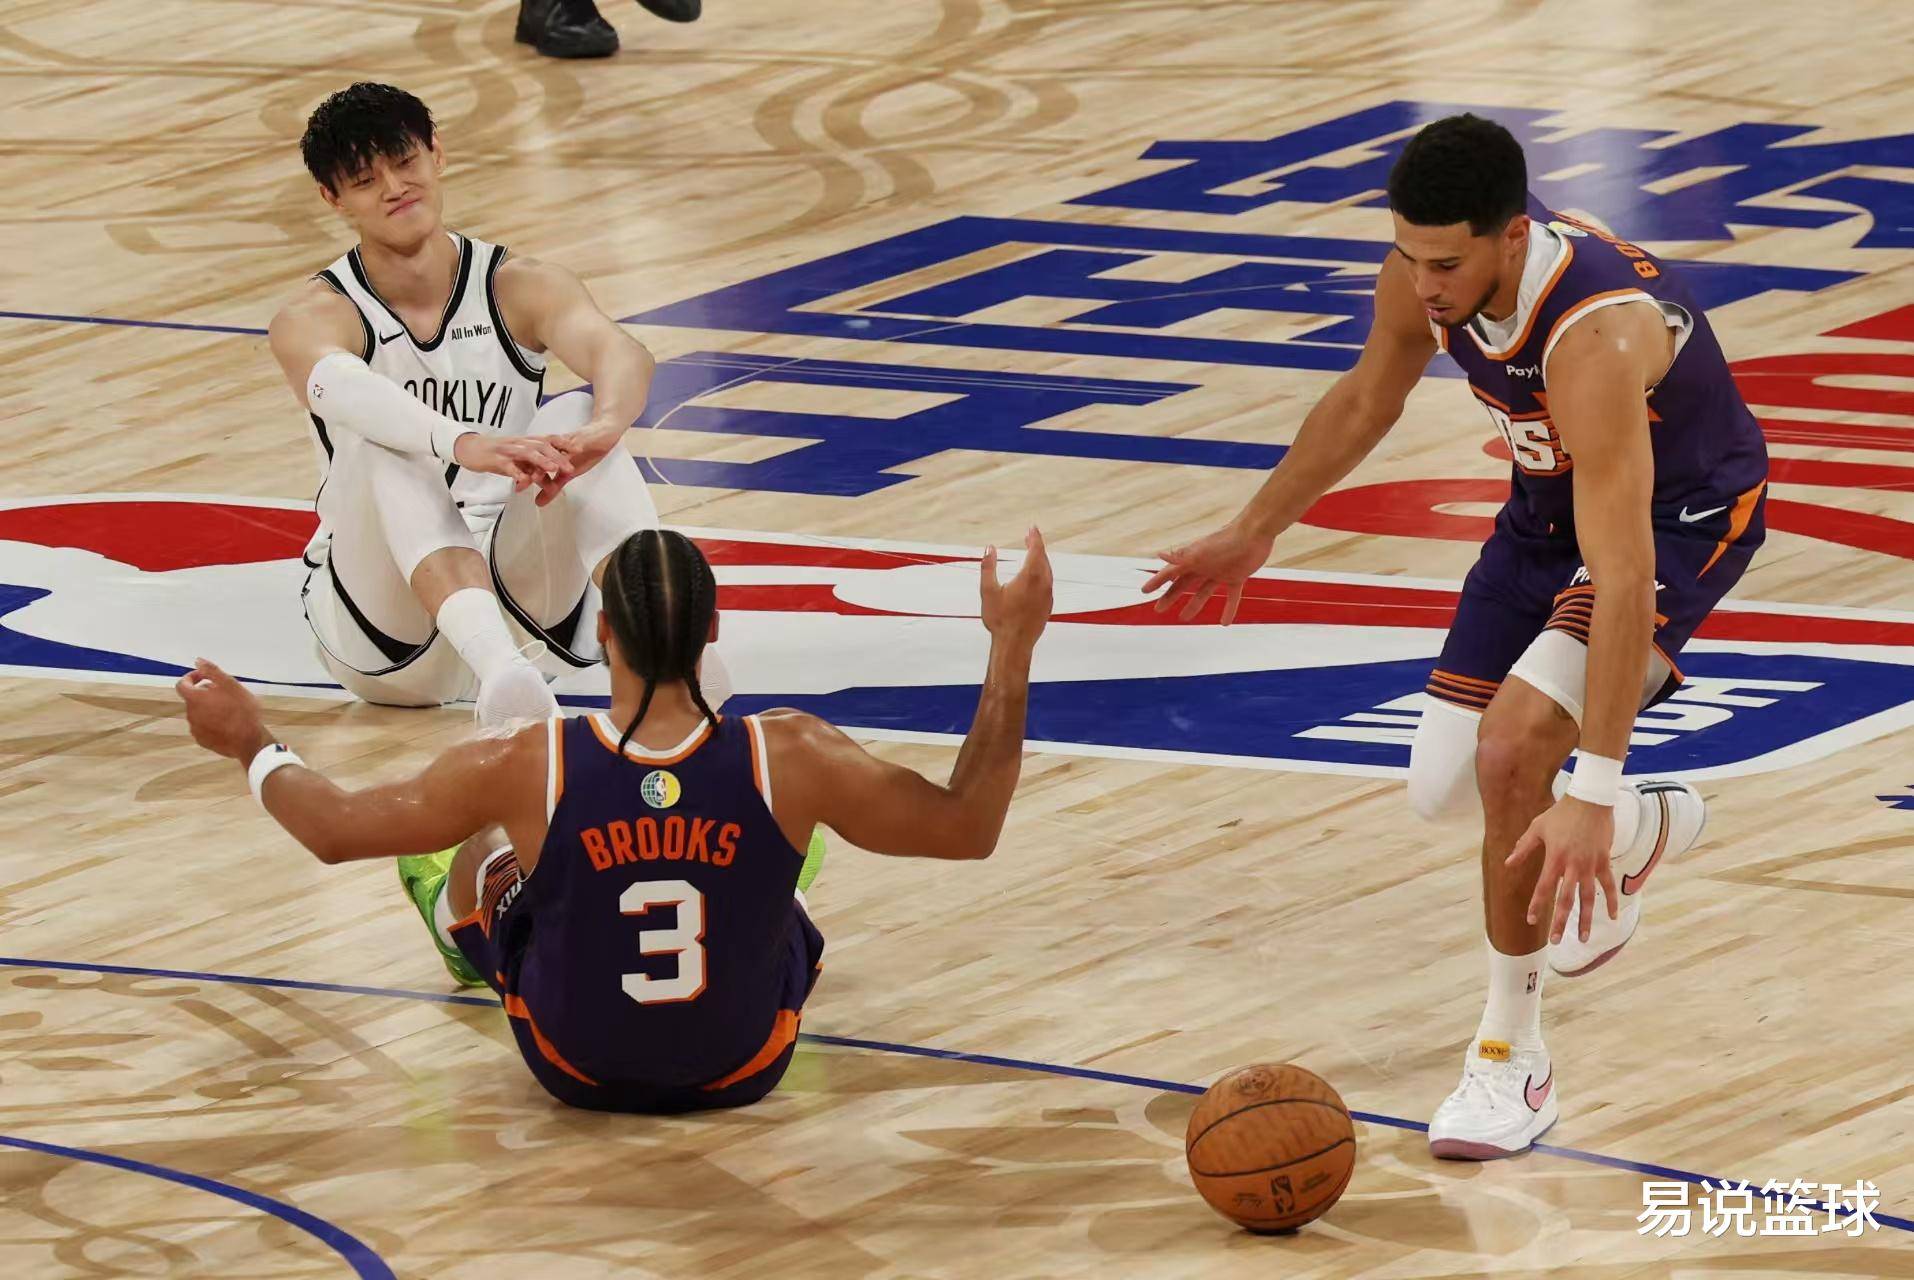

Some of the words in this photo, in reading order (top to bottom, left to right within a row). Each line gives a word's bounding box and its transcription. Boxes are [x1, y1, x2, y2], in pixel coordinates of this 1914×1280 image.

[451, 327, 463, 341] All
[464, 326, 473, 338] In
[1506, 364, 1544, 379] Pay
[404, 377, 512, 429] OKLYN
[580, 815, 742, 872] BROOKS
[619, 879, 707, 1006] 3
